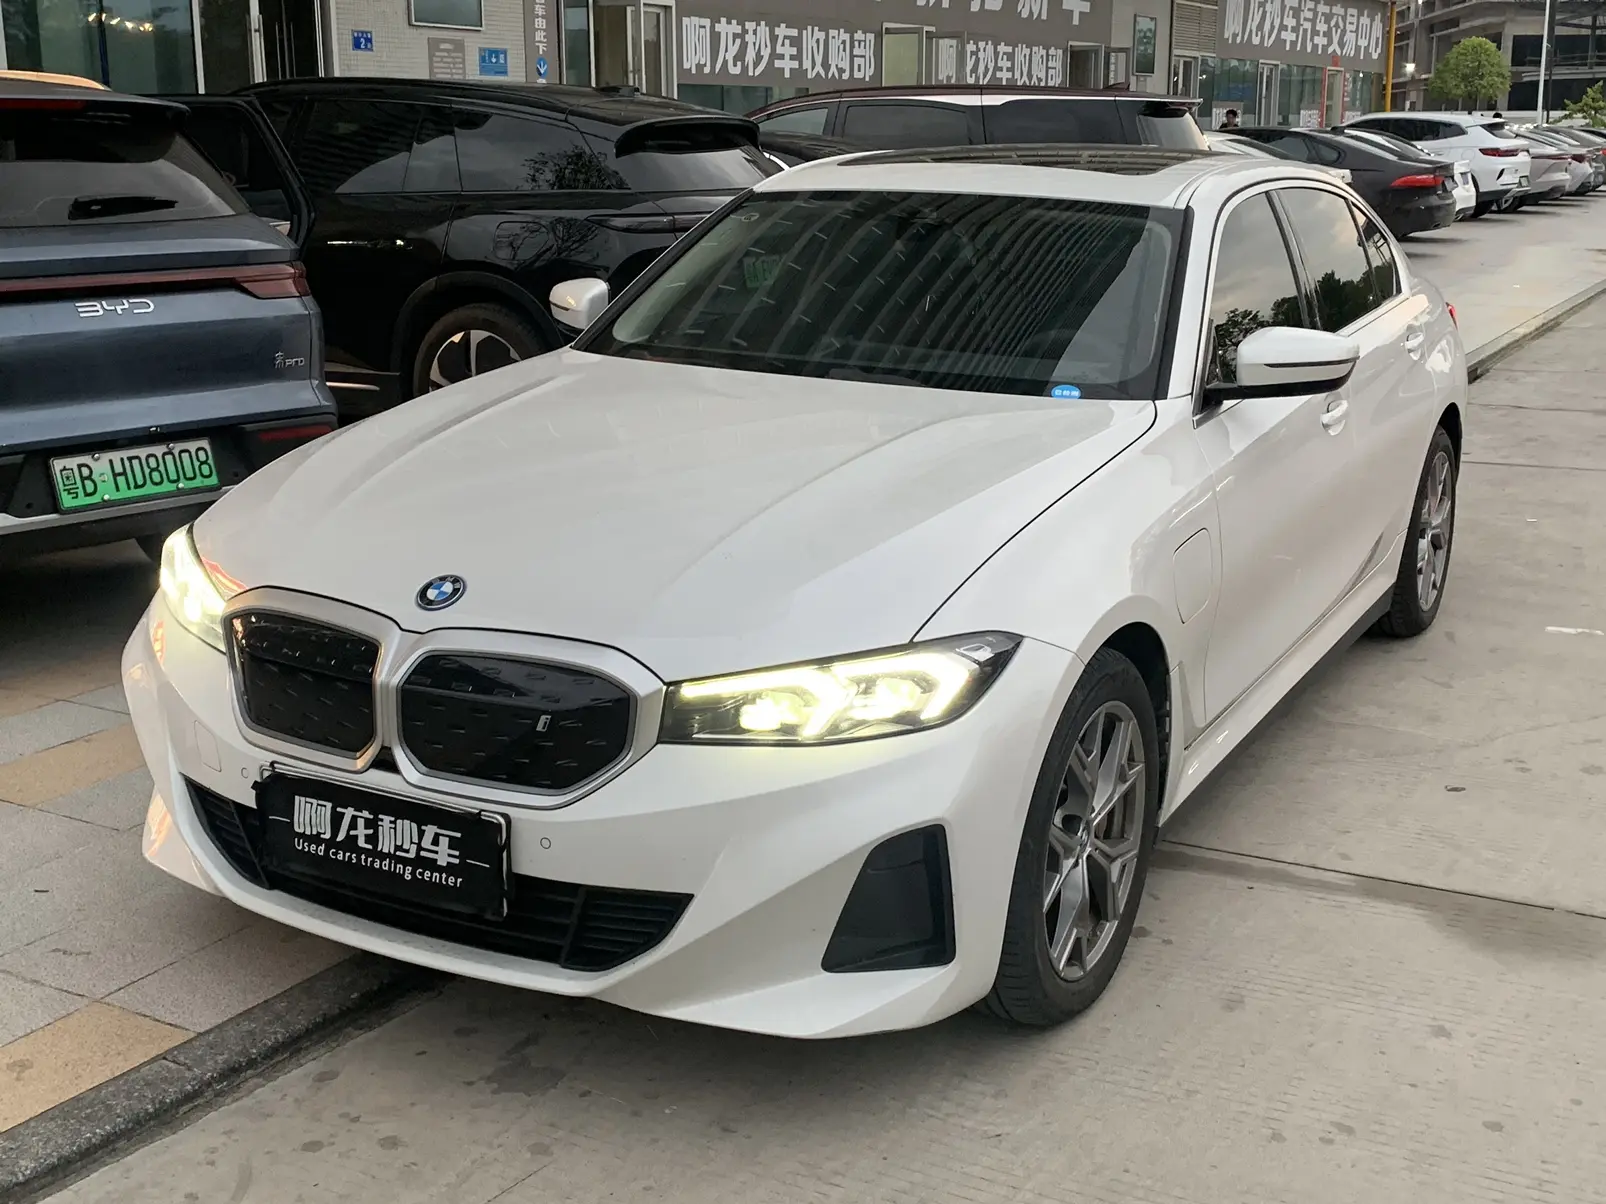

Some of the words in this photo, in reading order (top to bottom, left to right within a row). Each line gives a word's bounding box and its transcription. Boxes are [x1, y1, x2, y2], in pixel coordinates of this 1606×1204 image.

[534, 0, 547, 55] 车由此下
[681, 15, 876, 82] 啊龙秒车收购部
[1223, 0, 1383, 60] 啊龙秒车汽车交易中心
[75, 298, 155, 318] BYD
[293, 795, 462, 867] 啊龙秒车
[294, 837, 325, 857] Used
[329, 847, 358, 864] cars
[360, 853, 413, 880] trading
[415, 867, 464, 888] center
